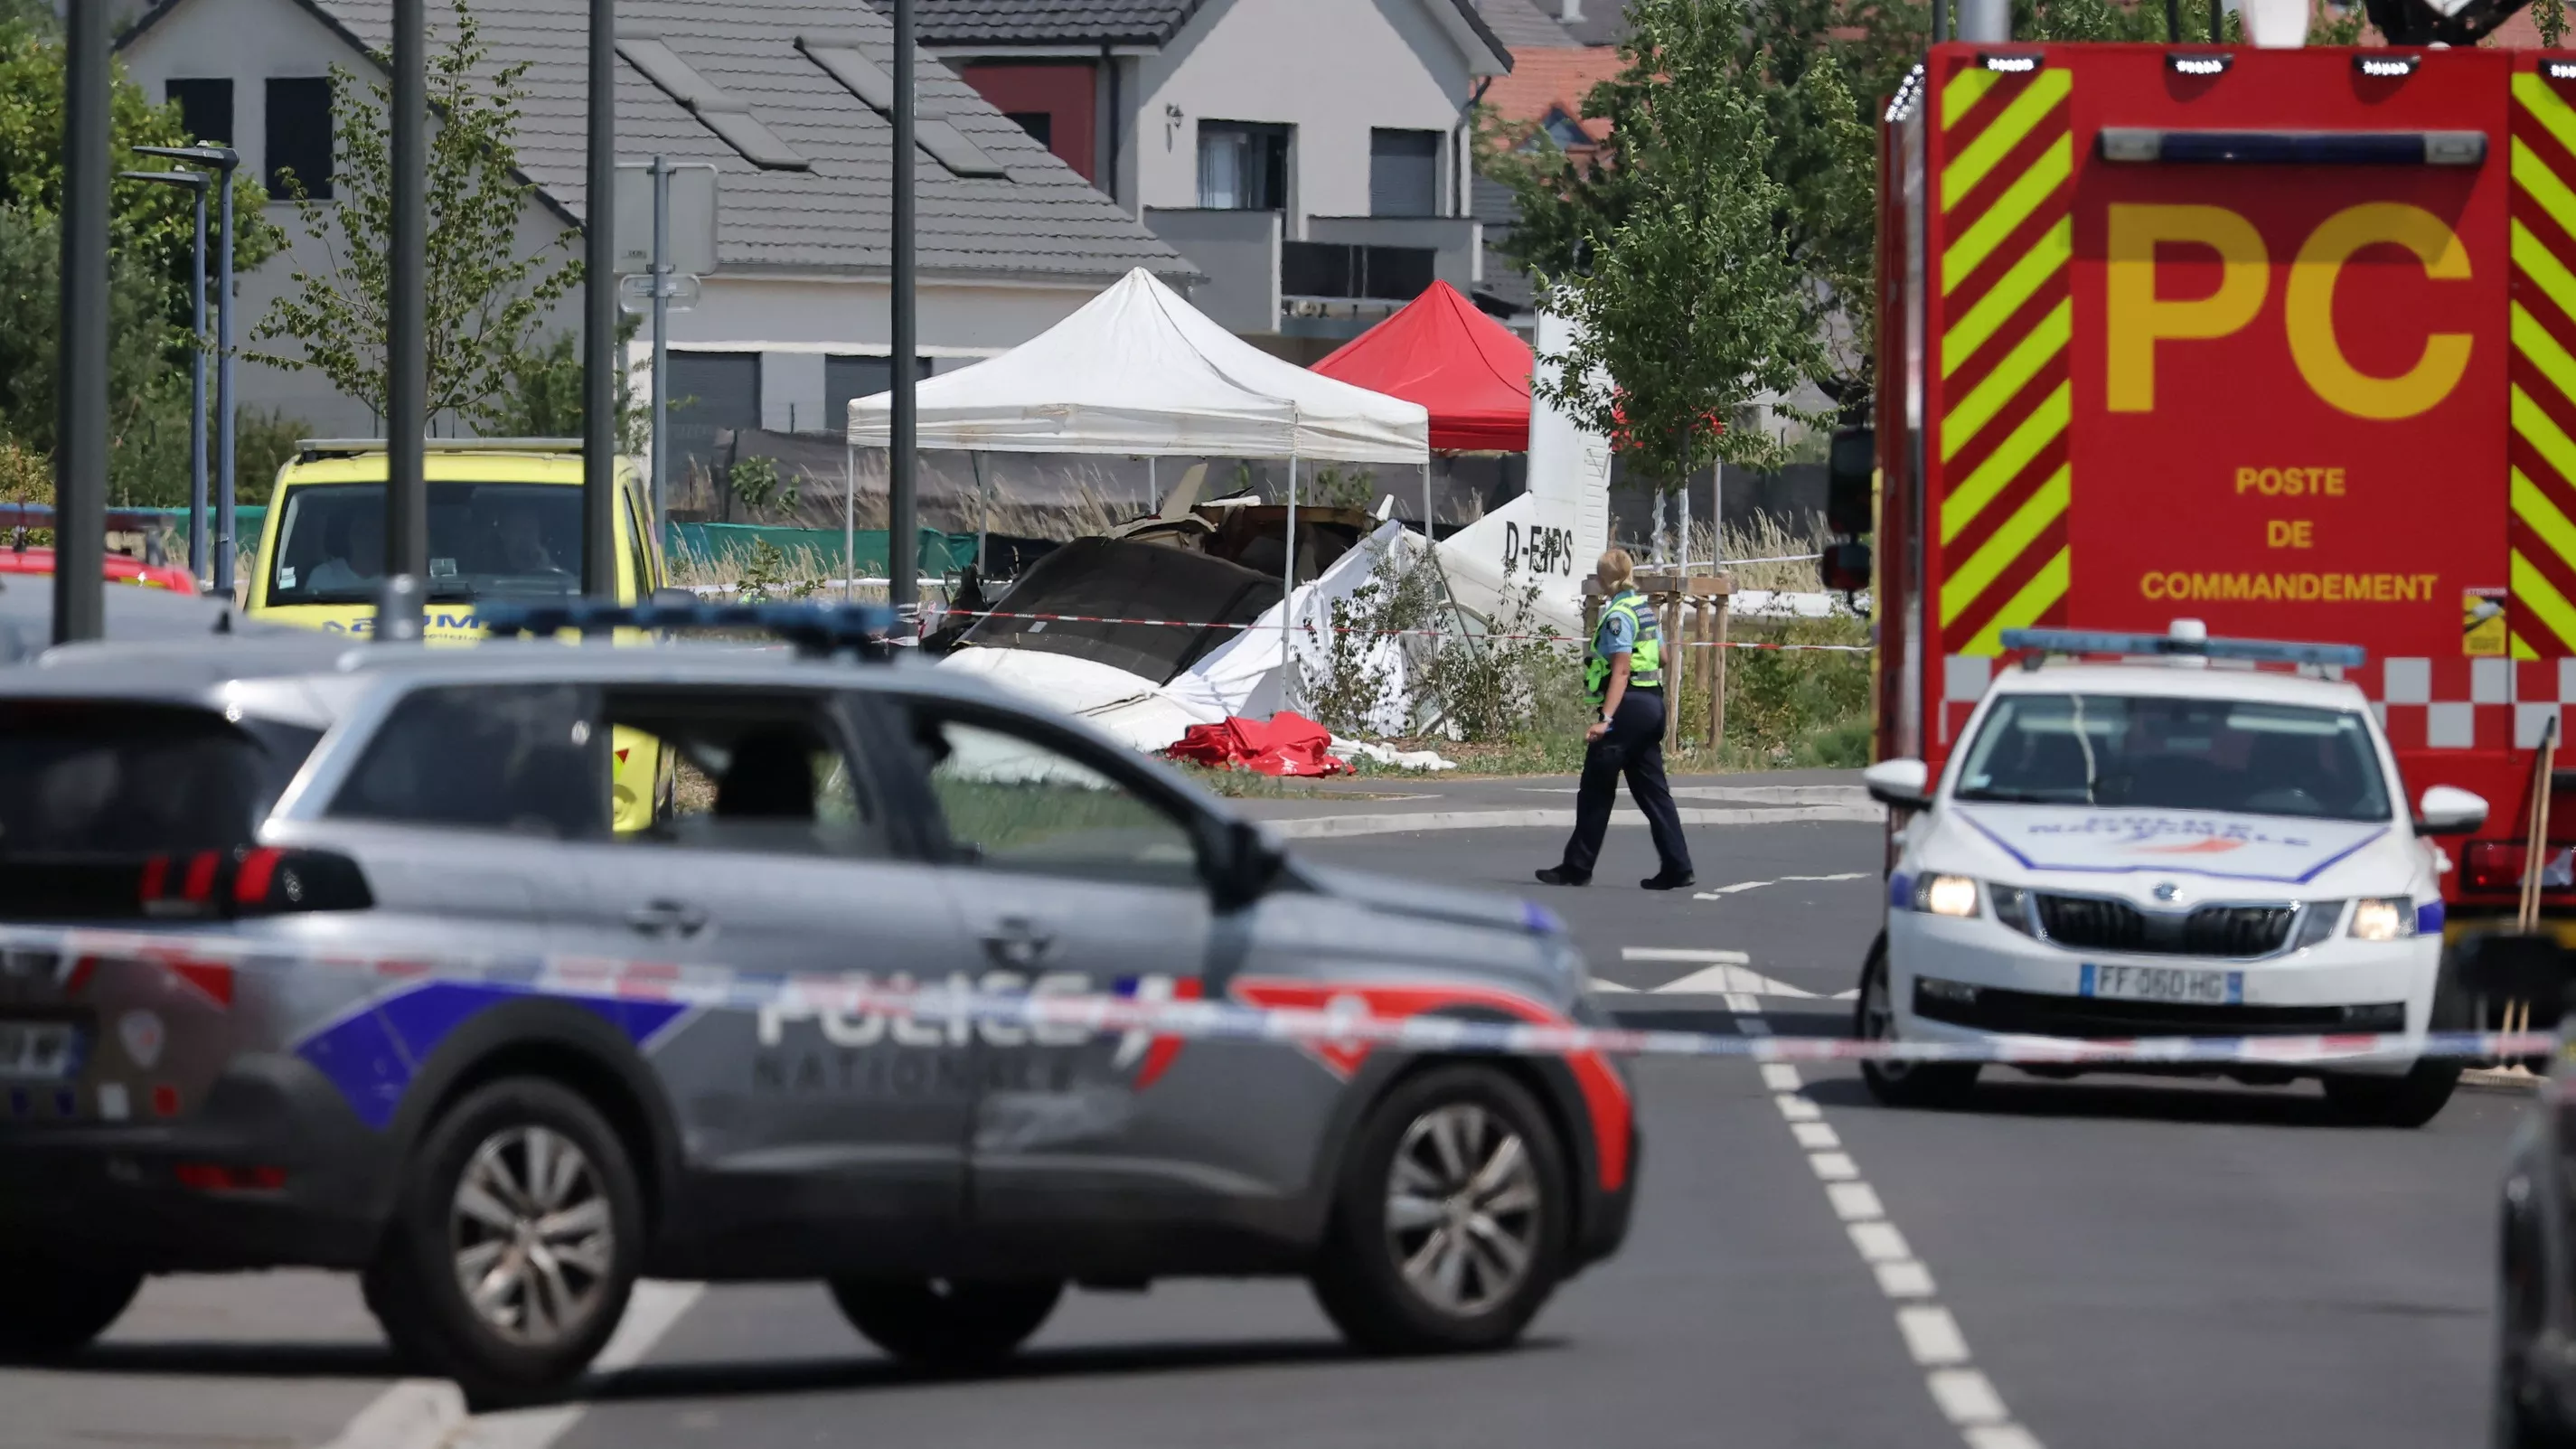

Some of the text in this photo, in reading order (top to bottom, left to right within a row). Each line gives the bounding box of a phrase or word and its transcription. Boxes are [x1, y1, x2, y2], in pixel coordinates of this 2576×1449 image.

[2107, 201, 2474, 421] PC
[2236, 466, 2346, 495] POSTE
[2267, 520, 2314, 548] DE
[2140, 571, 2438, 601] COMMANDEMENT
[2100, 965, 2132, 993] FF
[757, 969, 1092, 1048] POLICE
